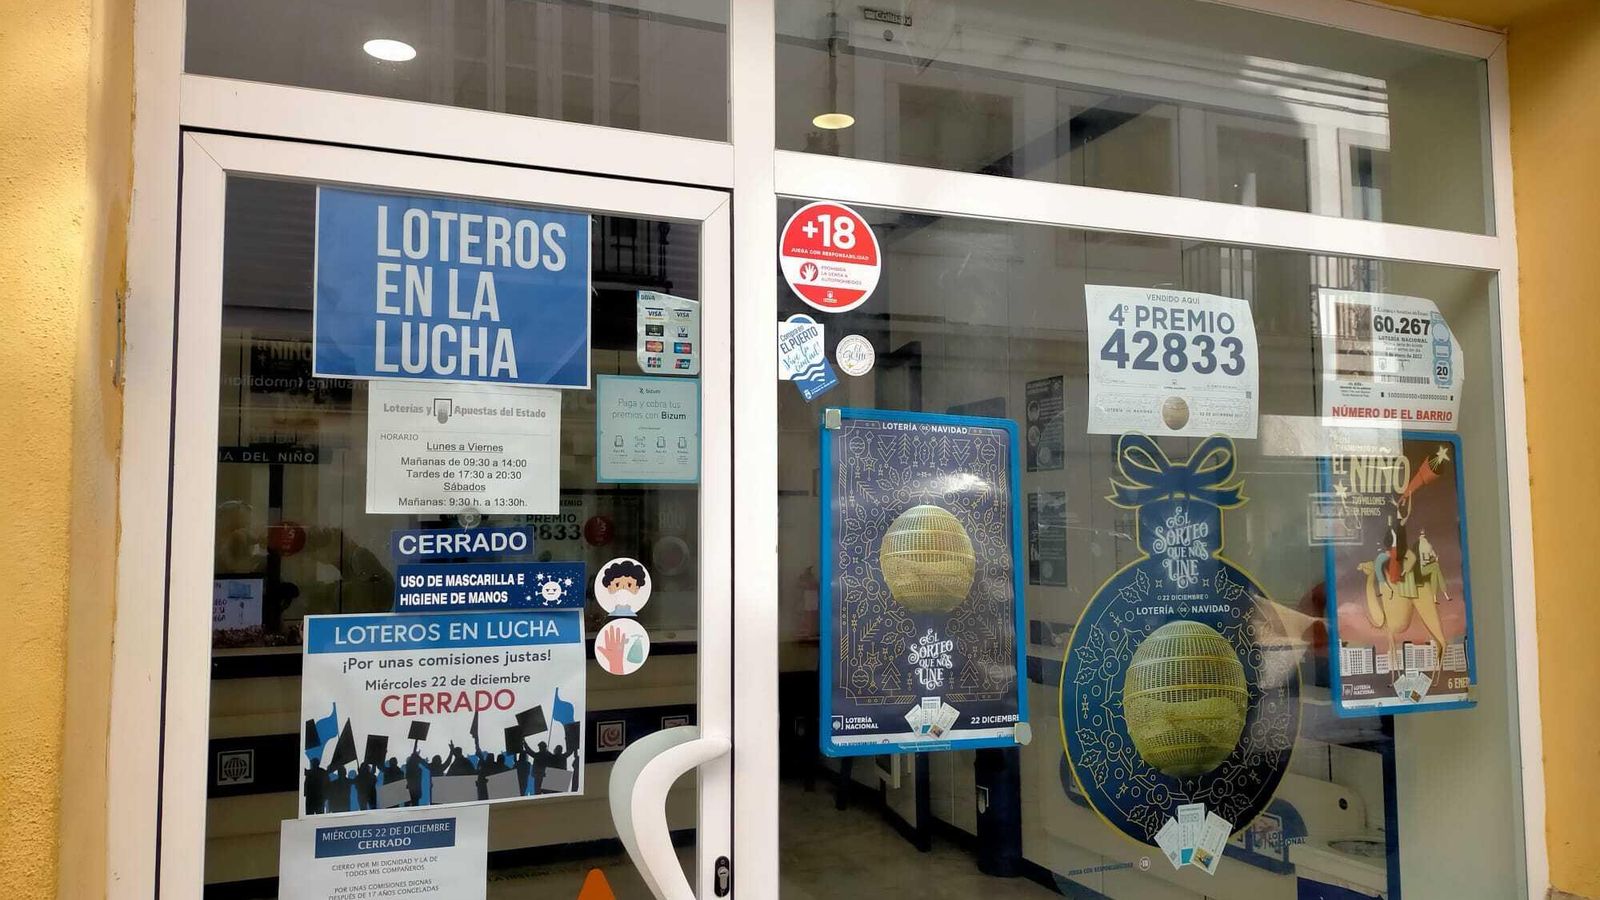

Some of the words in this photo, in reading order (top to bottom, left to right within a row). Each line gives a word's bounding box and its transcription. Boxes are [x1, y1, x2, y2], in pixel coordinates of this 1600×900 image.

[377, 205, 567, 272] LOTEROS
[801, 213, 856, 250] +18
[822, 250, 870, 261] RESPONSABILIDAD
[376, 262, 433, 317] EN
[448, 268, 500, 322] LA
[1146, 293, 1180, 304] VENDIDO
[1135, 305, 1235, 335] PREMIO
[1373, 314, 1431, 336] 60.267
[780, 341, 793, 355] EL
[788, 326, 819, 350] PUERTO
[1401, 336, 1428, 344] NACIONAL
[375, 320, 519, 379] LUCHA
[1100, 328, 1246, 377] 42833
[1436, 366, 1448, 376] 20
[383, 403, 424, 414] Loterías
[425, 405, 432, 416] y
[454, 405, 498, 418] Apuestas
[499, 406, 514, 417] del
[516, 408, 547, 419] Estado
[618, 398, 638, 409] Paga
[639, 401, 646, 409] y
[646, 400, 667, 408] cobra
[669, 401, 681, 409] tus
[612, 411, 644, 420] premios
[644, 412, 659, 420] con
[661, 411, 687, 420] Bizum
[1332, 405, 1380, 419] NÚMERO
[1384, 408, 1397, 419] DE
[1400, 409, 1413, 420] EL
[1416, 409, 1453, 421] BARRIO
[882, 421, 918, 432] LOTERÍA
[931, 425, 968, 435] NAVIDAD
[380, 433, 419, 441] HORARIO
[426, 442, 456, 451] Lunes
[467, 442, 504, 452] Viernes
[242, 451, 269, 461] DEL
[278, 450, 315, 462] NIÑO
[400, 456, 446, 466] Mañanas
[448, 457, 461, 466] de
[463, 457, 490, 467] 09:30
[492, 459, 499, 467] a
[501, 458, 527, 468] 14:00
[406, 469, 440, 479] Tardes
[442, 470, 455, 479] de
[458, 470, 485, 479] 17:30
[495, 471, 522, 480] 20:30
[1332, 454, 1347, 475] EL
[1350, 446, 1411, 495] NIÑO
[443, 482, 486, 491] Sábados
[398, 497, 447, 506] Mañanas:
[449, 498, 471, 506] 9:30
[473, 498, 482, 507] h.
[484, 499, 491, 507] a
[494, 498, 528, 507] 13:30h.
[526, 513, 577, 524] PREMIO
[1165, 506, 1191, 528] EL
[533, 523, 582, 541] 833
[1152, 521, 1209, 554] SORTEO
[398, 531, 527, 555] CERRADO
[1167, 546, 1188, 559] QUE
[1188, 539, 1209, 560] NOS
[400, 575, 425, 588] USO
[427, 575, 443, 587] DE
[445, 573, 515, 587] MASCARILLA
[518, 573, 525, 585] E
[1161, 558, 1200, 589] UNE
[400, 593, 448, 606] HIGIENE
[450, 592, 465, 605] DE
[468, 591, 508, 604] MANOS
[1170, 593, 1204, 601] DICIEMBRE
[1136, 605, 1175, 615] LOTERÍA
[1191, 604, 1230, 614] NAVIDAD
[335, 623, 441, 645] LOTEROS
[450, 622, 479, 640] EN
[486, 620, 560, 639] LUCHA
[919, 628, 939, 645] EL
[907, 639, 954, 665] SORTEO
[342, 657, 373, 674] ¡Por
[378, 657, 414, 669] unas
[418, 652, 500, 667] comisiones
[503, 649, 552, 666] justas!
[919, 659, 936, 667] QUE
[936, 654, 953, 669] NOS
[365, 677, 427, 691] Miércoles
[431, 676, 447, 688] 22
[450, 675, 466, 686] de
[469, 672, 531, 686] diciembre
[914, 667, 945, 691] UNE
[1447, 678, 1454, 690] 6
[1353, 688, 1375, 696] NACIONAL
[380, 688, 516, 718] CERRADO
[845, 715, 873, 724] LOTERÍA
[970, 717, 980, 725] 22
[845, 722, 879, 731] NACIONAL
[322, 826, 373, 841] MIÉRCOLES
[375, 827, 387, 837] 22
[389, 826, 401, 836] DE
[403, 822, 450, 835] DICIEMBRE
[357, 837, 412, 850] CERRADO
[331, 863, 355, 872] CIERRO
[357, 862, 370, 870] POR
[380, 858, 413, 868] DIGNIDAD
[345, 869, 368, 878] TODOS
[382, 864, 425, 875] COMPAÑEROS
[334, 886, 348, 894] POR
[349, 885, 367, 893] UNAS
[368, 881, 408, 891] COMISIONES
[408, 878, 432, 888] DIGNAS
[357, 892, 367, 900] DE
[368, 891, 377, 899] 17
[377, 888, 397, 898] AÑOS
